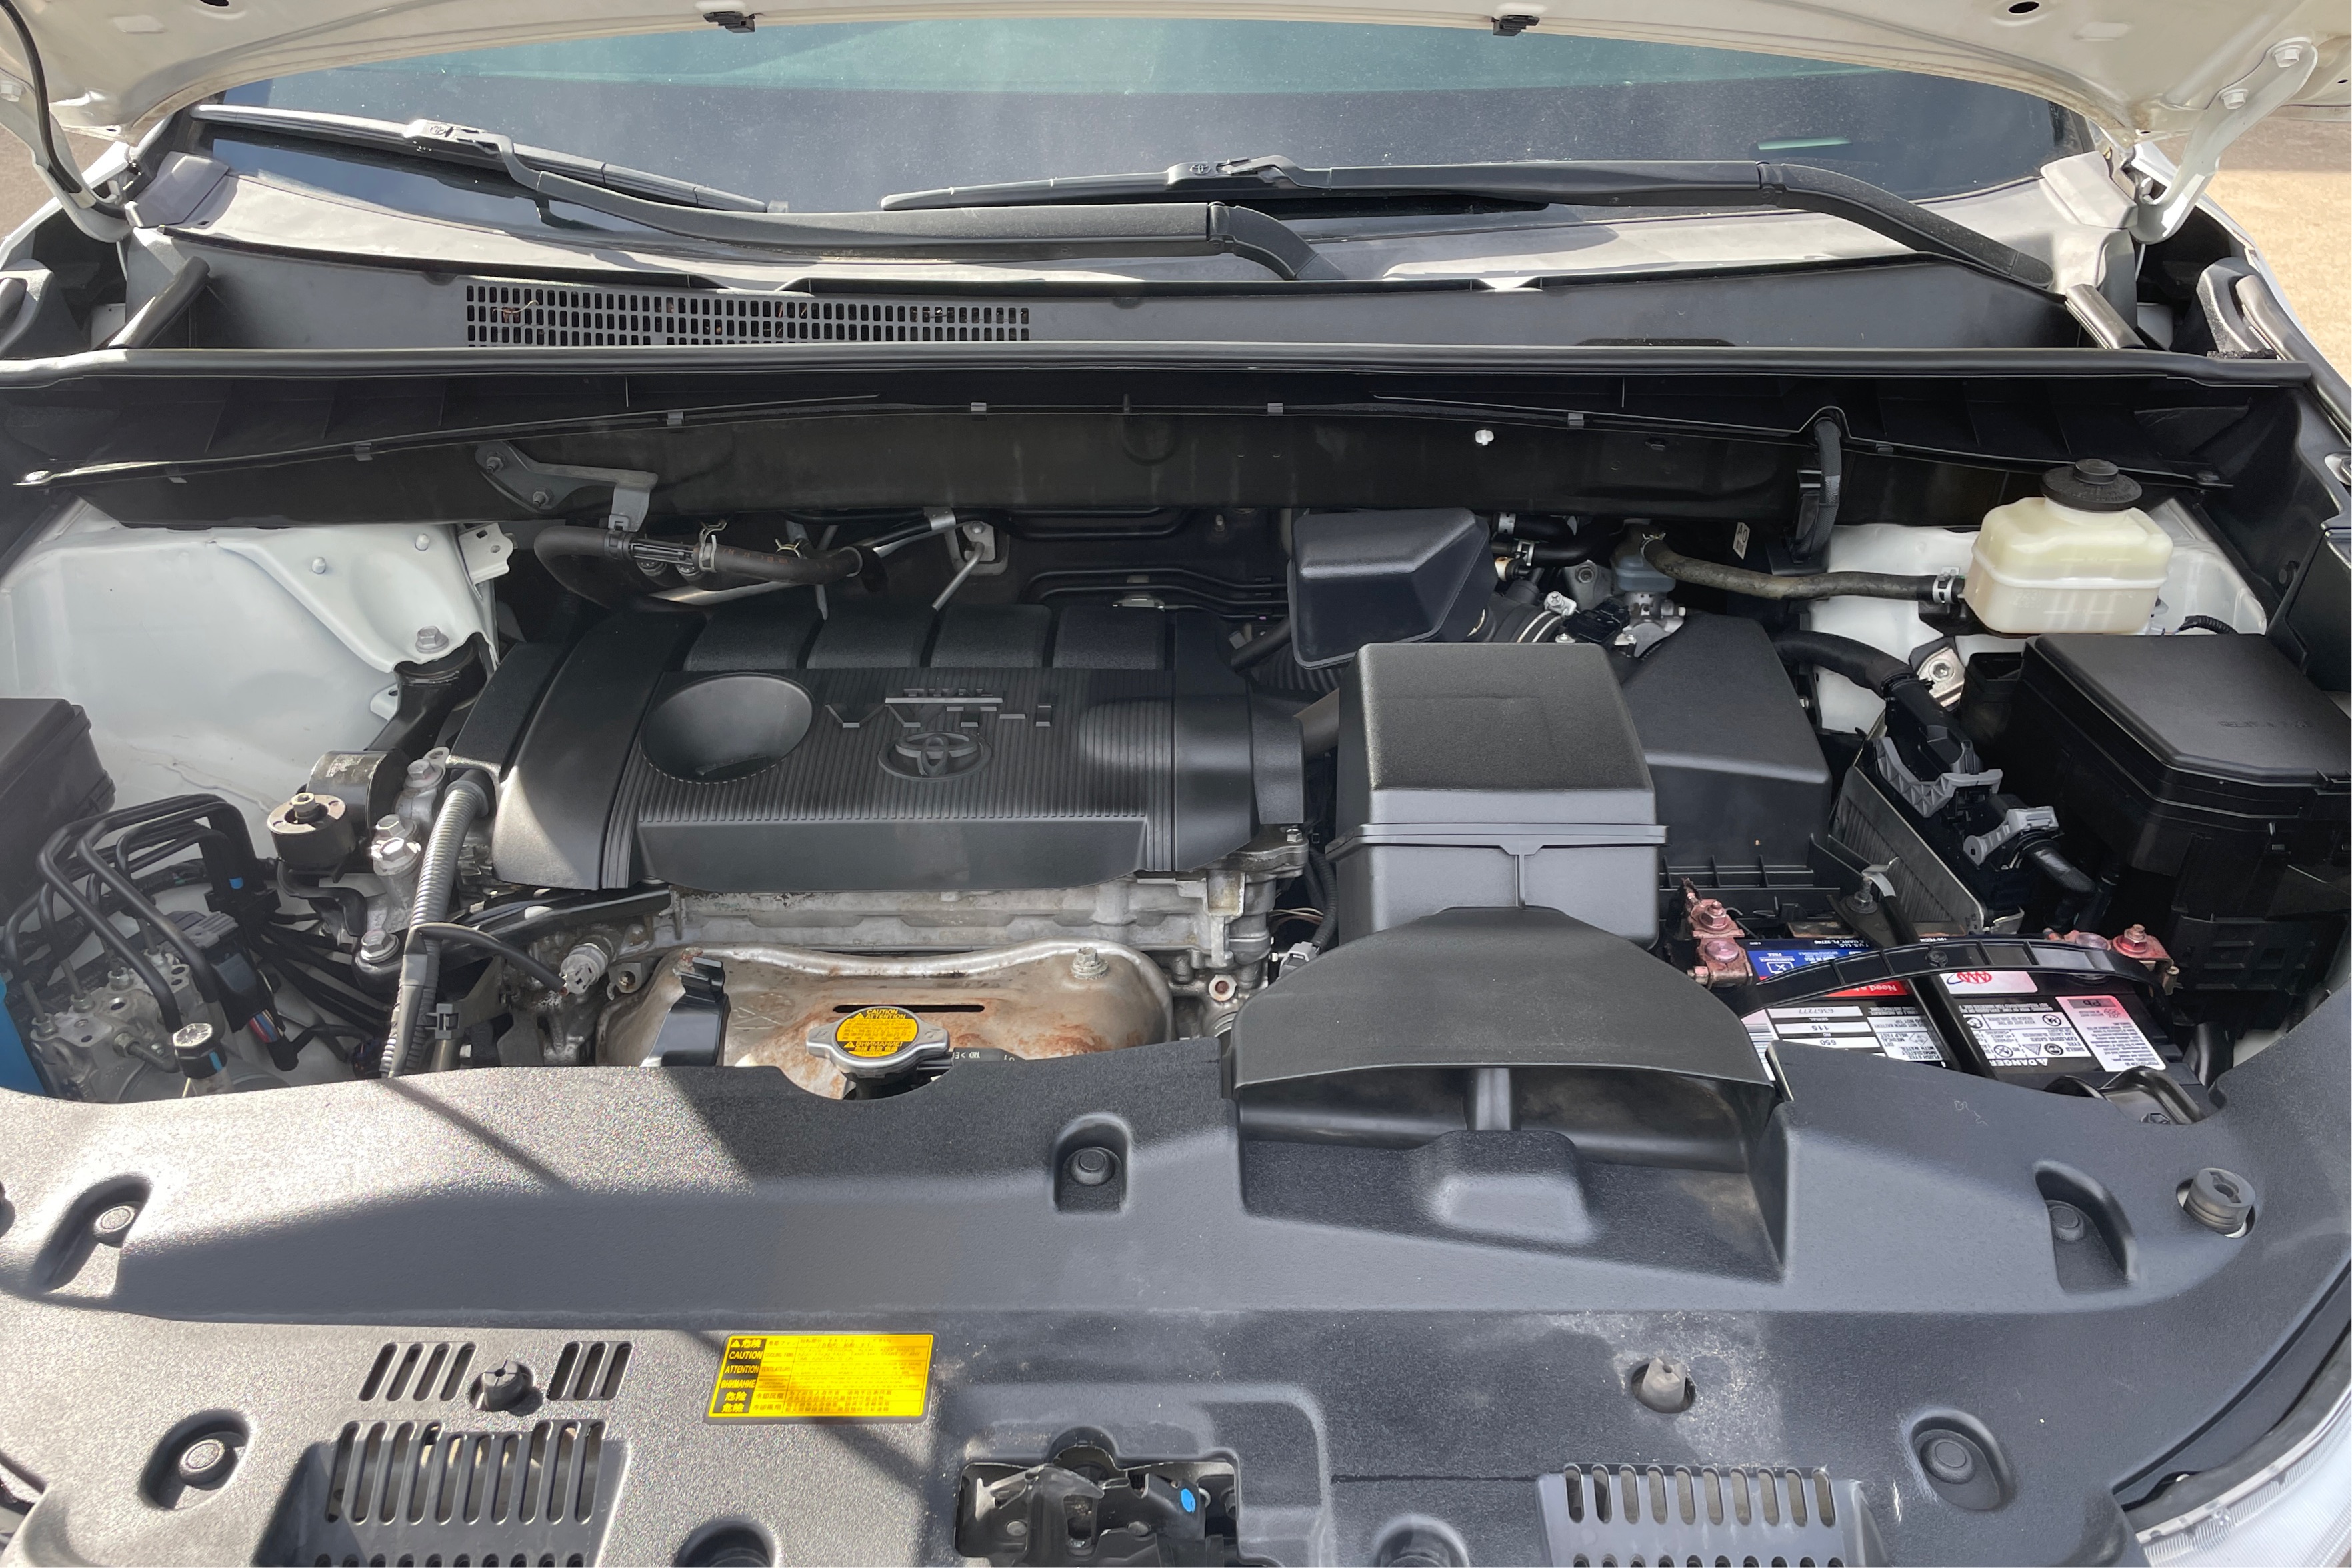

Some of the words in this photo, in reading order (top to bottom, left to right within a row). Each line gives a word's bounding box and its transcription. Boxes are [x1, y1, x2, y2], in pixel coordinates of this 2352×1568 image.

[729, 1351, 763, 1359] CAUTION
[724, 1365, 760, 1374] ATTENTION
[720, 1379, 757, 1388] ВНИМАНИЕ
